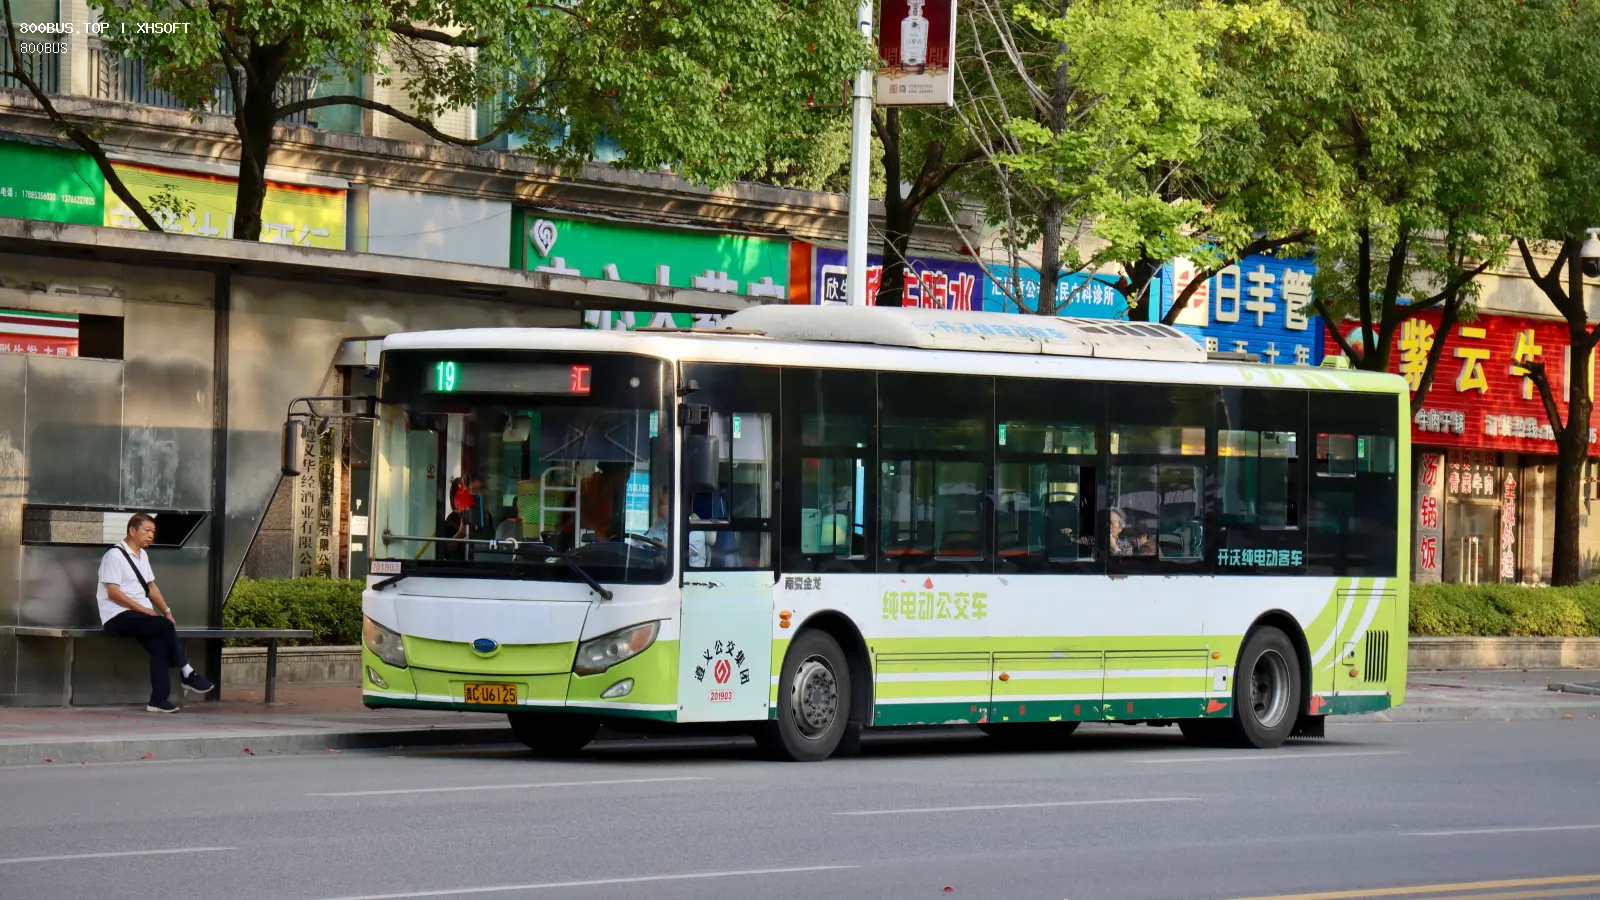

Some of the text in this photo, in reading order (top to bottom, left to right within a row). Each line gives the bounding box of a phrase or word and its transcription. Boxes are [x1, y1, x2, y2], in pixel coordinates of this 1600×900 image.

[991, 276, 1115, 306] 汇川公民内科诊所
[1215, 263, 1313, 332] 日丰管
[1398, 317, 1596, 404] 紫云牛
[436, 361, 456, 391] 19
[571, 366, 590, 391] 汇
[1415, 408, 1466, 435] 牛肉干锅
[1450, 472, 1494, 496] 青菜牛肉
[1420, 453, 1438, 569] 汤锅饭
[1501, 473, 1517, 578] 全城外送
[372, 562, 399, 573] 201903
[1218, 548, 1303, 567] 开沃纯电动客车
[785, 576, 821, 590] 南京金龙
[882, 591, 988, 620] 纯电动公交车
[694, 639, 750, 685] 遵义公交集团
[710, 692, 733, 701] 201903
